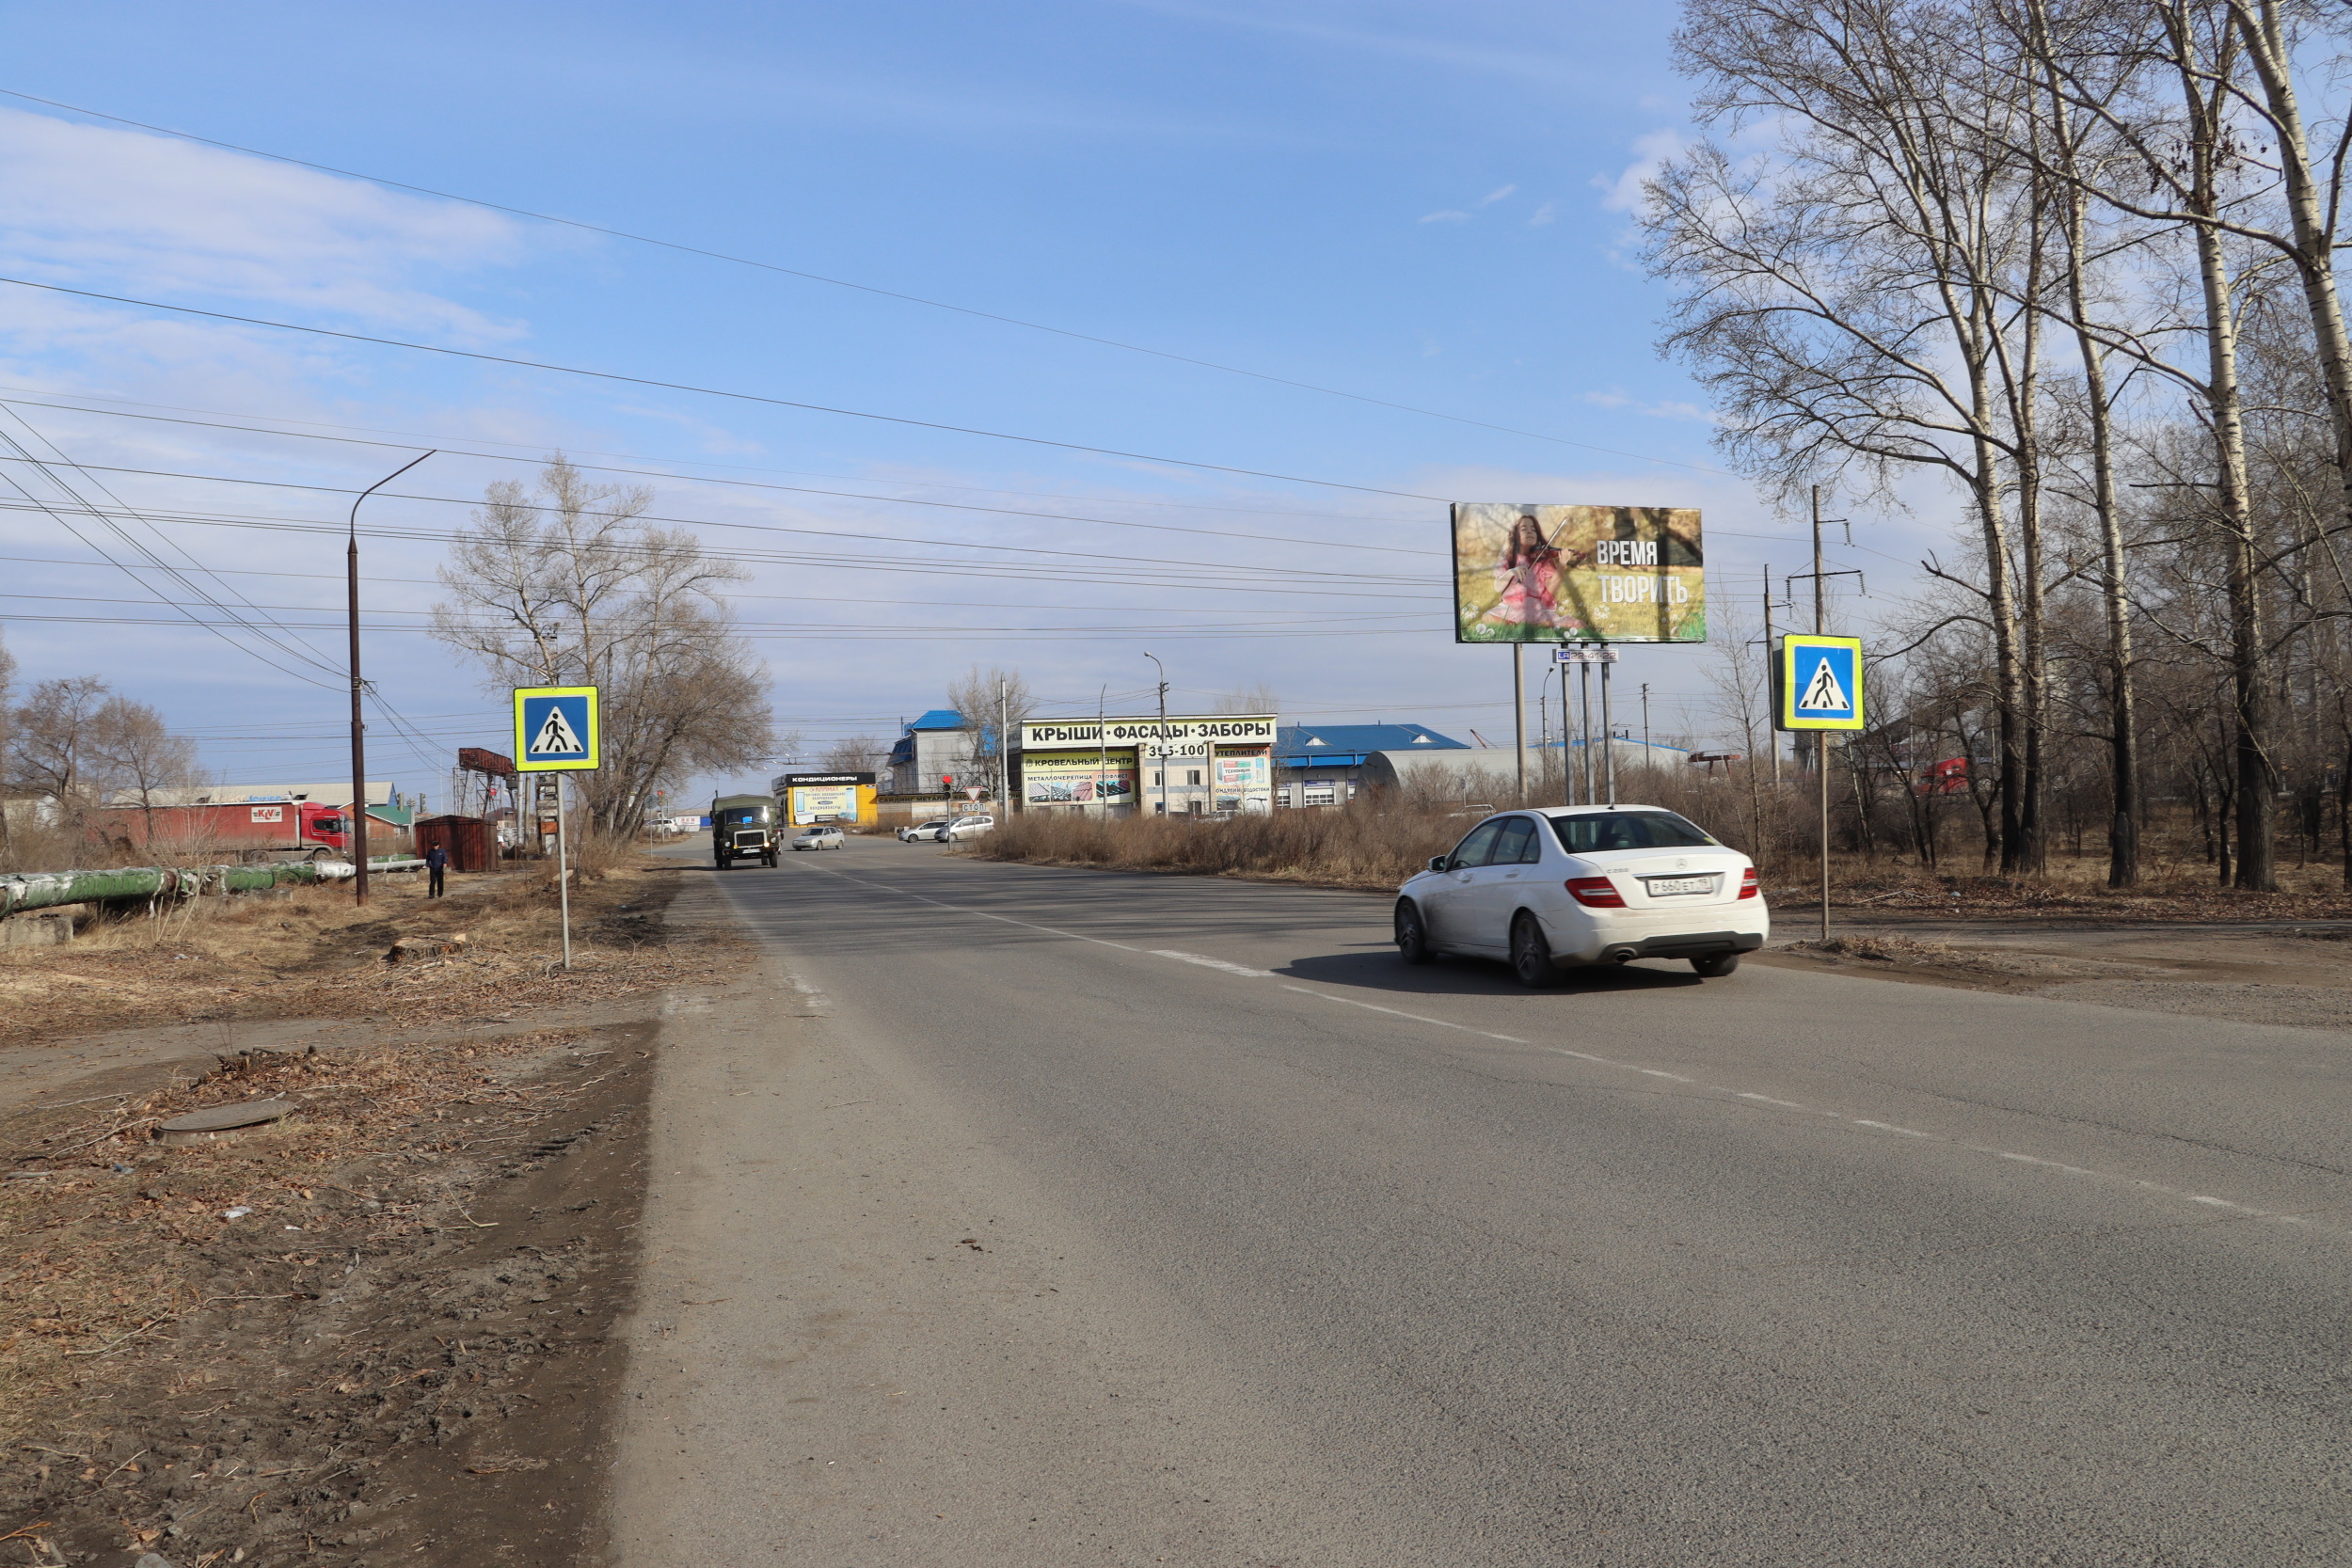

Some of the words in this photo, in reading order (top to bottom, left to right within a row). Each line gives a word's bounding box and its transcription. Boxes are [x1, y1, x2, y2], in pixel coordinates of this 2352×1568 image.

[1597, 540, 1659, 565] ВРЕМЯ
[1597, 575, 1689, 604] ТВОРИТЬ
[1032, 726, 1103, 741] КРЫШИ
[1113, 723, 1188, 740] ФАСАДЫ
[1198, 722, 1271, 736] ЗАБОРЫ
[1035, 757, 1100, 767] КРОВЕЛЬНЫЙ
[258, 809, 274, 820] KLV
[963, 803, 985, 812] СТОП
